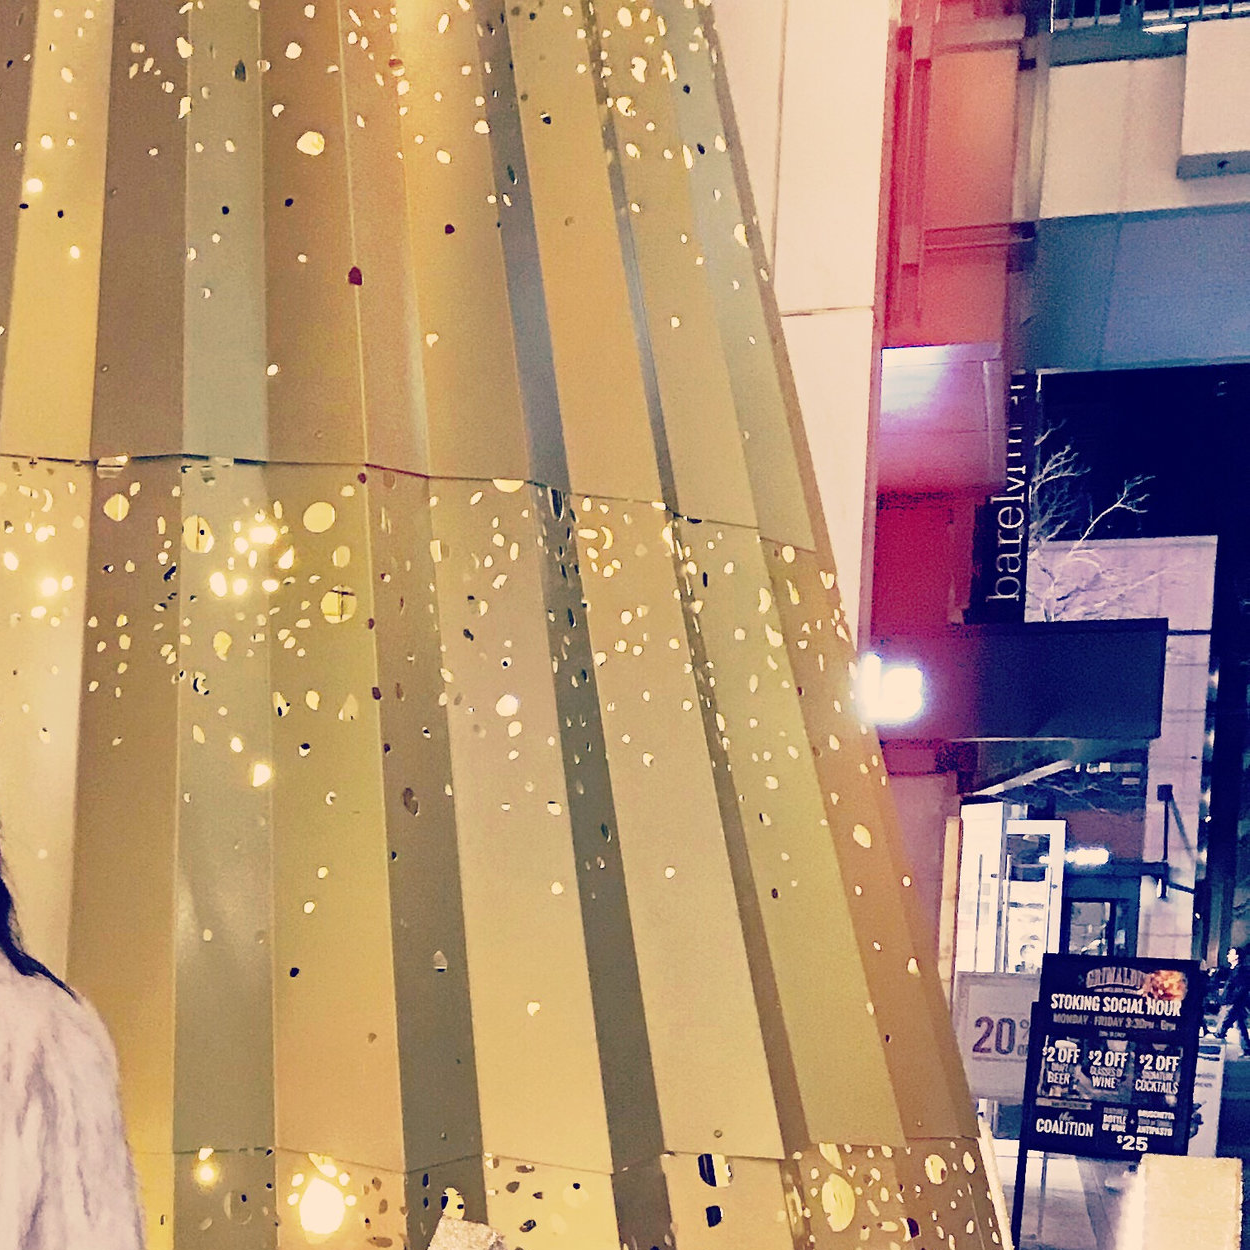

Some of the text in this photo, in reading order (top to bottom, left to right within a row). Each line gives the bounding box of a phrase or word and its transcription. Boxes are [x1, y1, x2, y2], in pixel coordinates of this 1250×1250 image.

[1051, 993, 1182, 1017] STOKING SOCIAL HOUR
[1052, 1013, 1089, 1025] MONDAY
[1094, 1016, 1124, 1028] FRIDAY
[1042, 1046, 1056, 1062] $2
[1057, 1048, 1081, 1064] OFF
[1088, 1050, 1129, 1068] $2 OFF
[1139, 1054, 1180, 1072] $2 OFF
[1047, 1071, 1070, 1084] BEER
[1092, 1076, 1117, 1089] WINE
[1135, 1079, 1179, 1095] COCKTAILS
[1036, 1118, 1094, 1137] COALITION
[1116, 1134, 1148, 1152] $25
